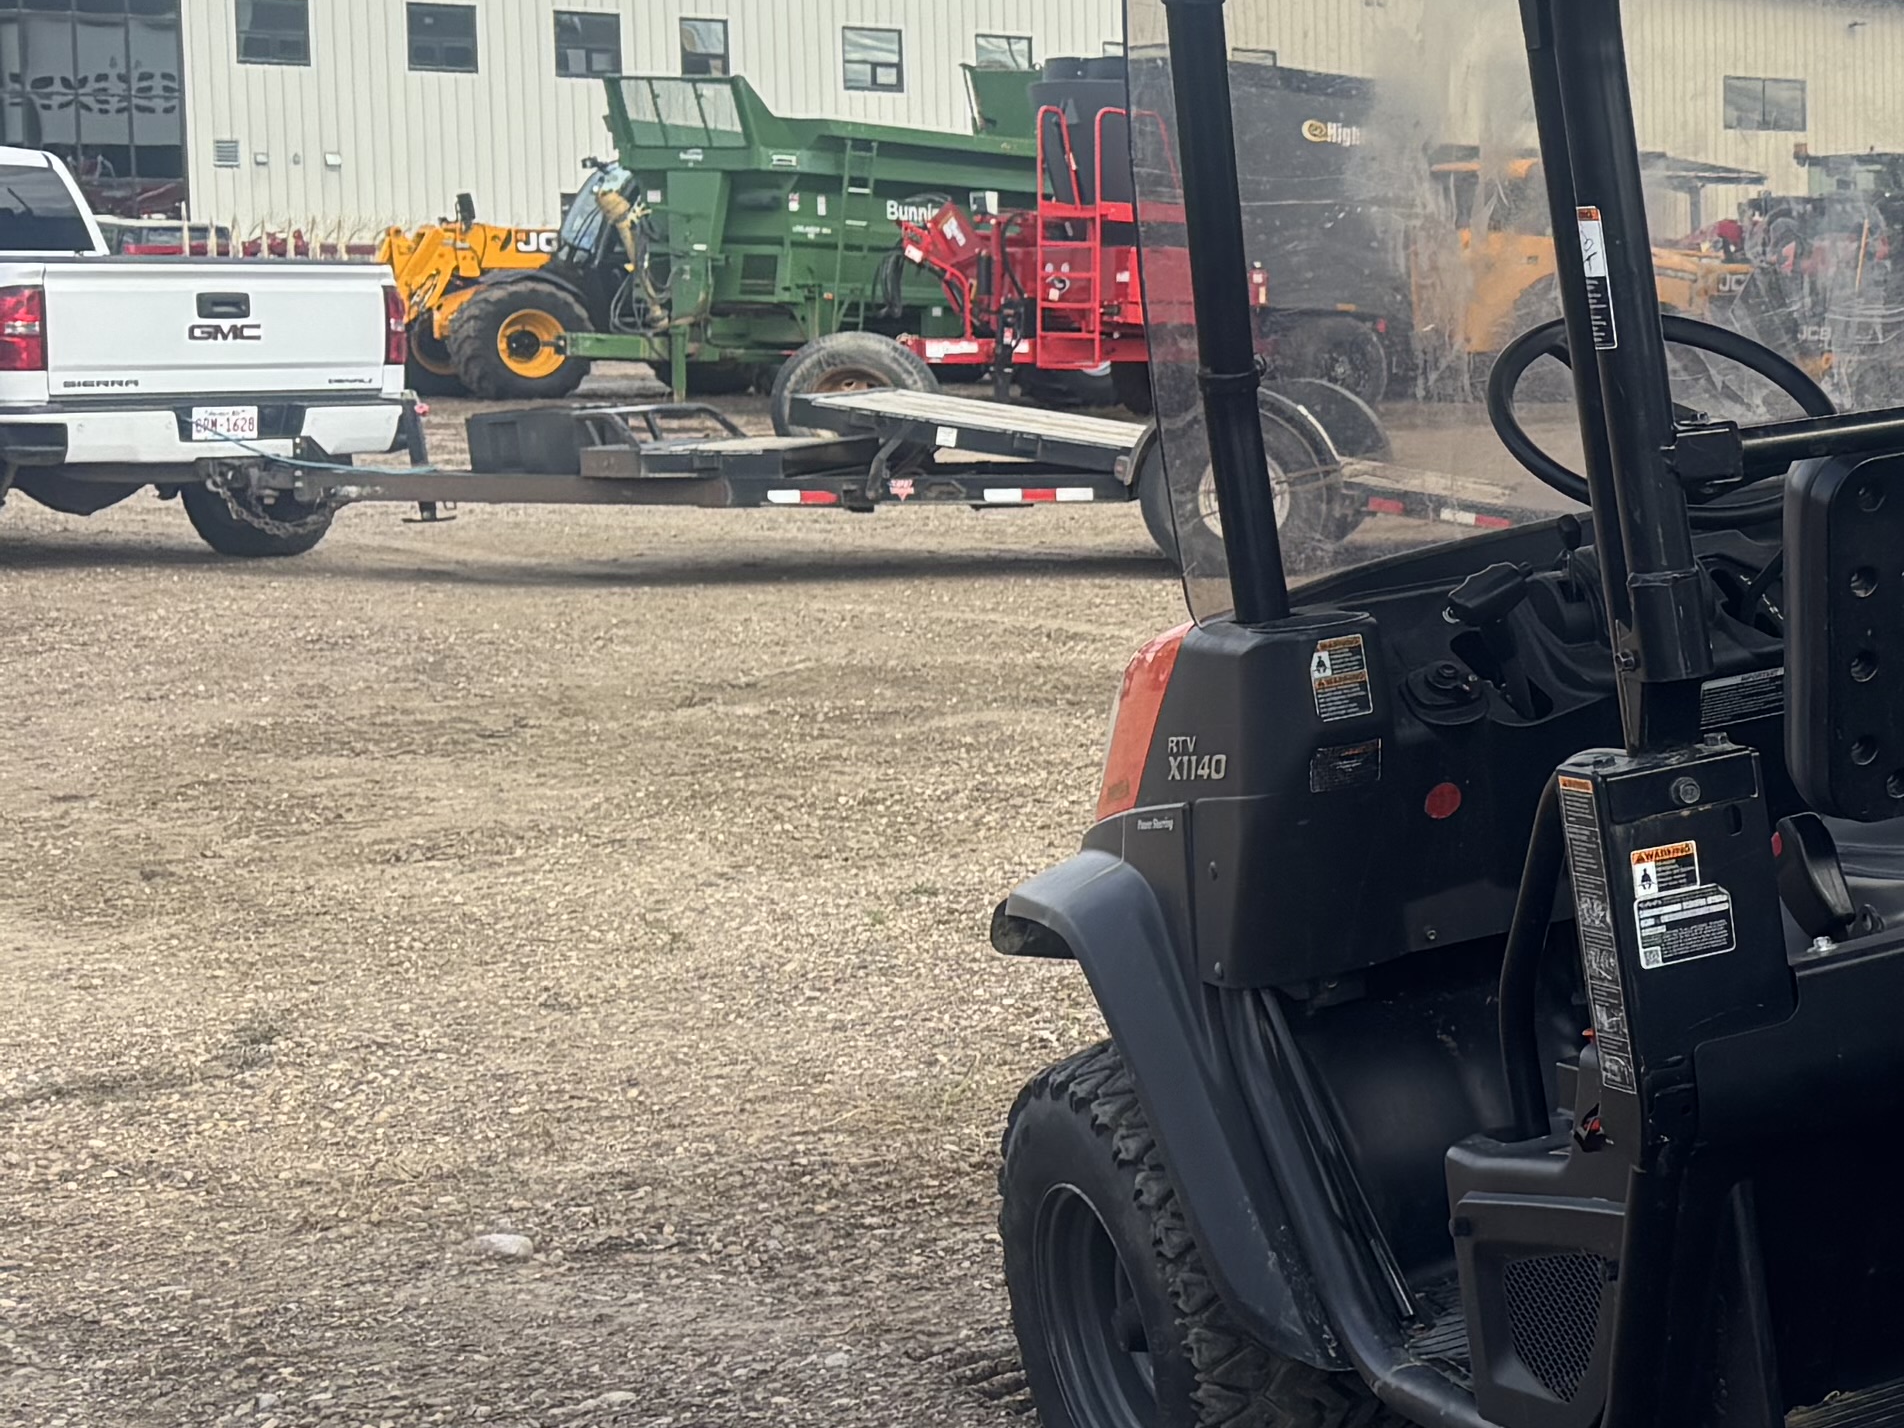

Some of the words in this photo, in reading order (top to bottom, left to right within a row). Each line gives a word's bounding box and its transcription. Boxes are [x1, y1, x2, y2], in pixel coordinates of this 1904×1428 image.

[886, 200, 940, 222] Bunni
[516, 231, 559, 253] JC
[188, 323, 262, 341] GMC
[63, 378, 139, 388] SIERRA
[1167, 735, 1196, 753] RTV
[1167, 754, 1227, 780] X1140
